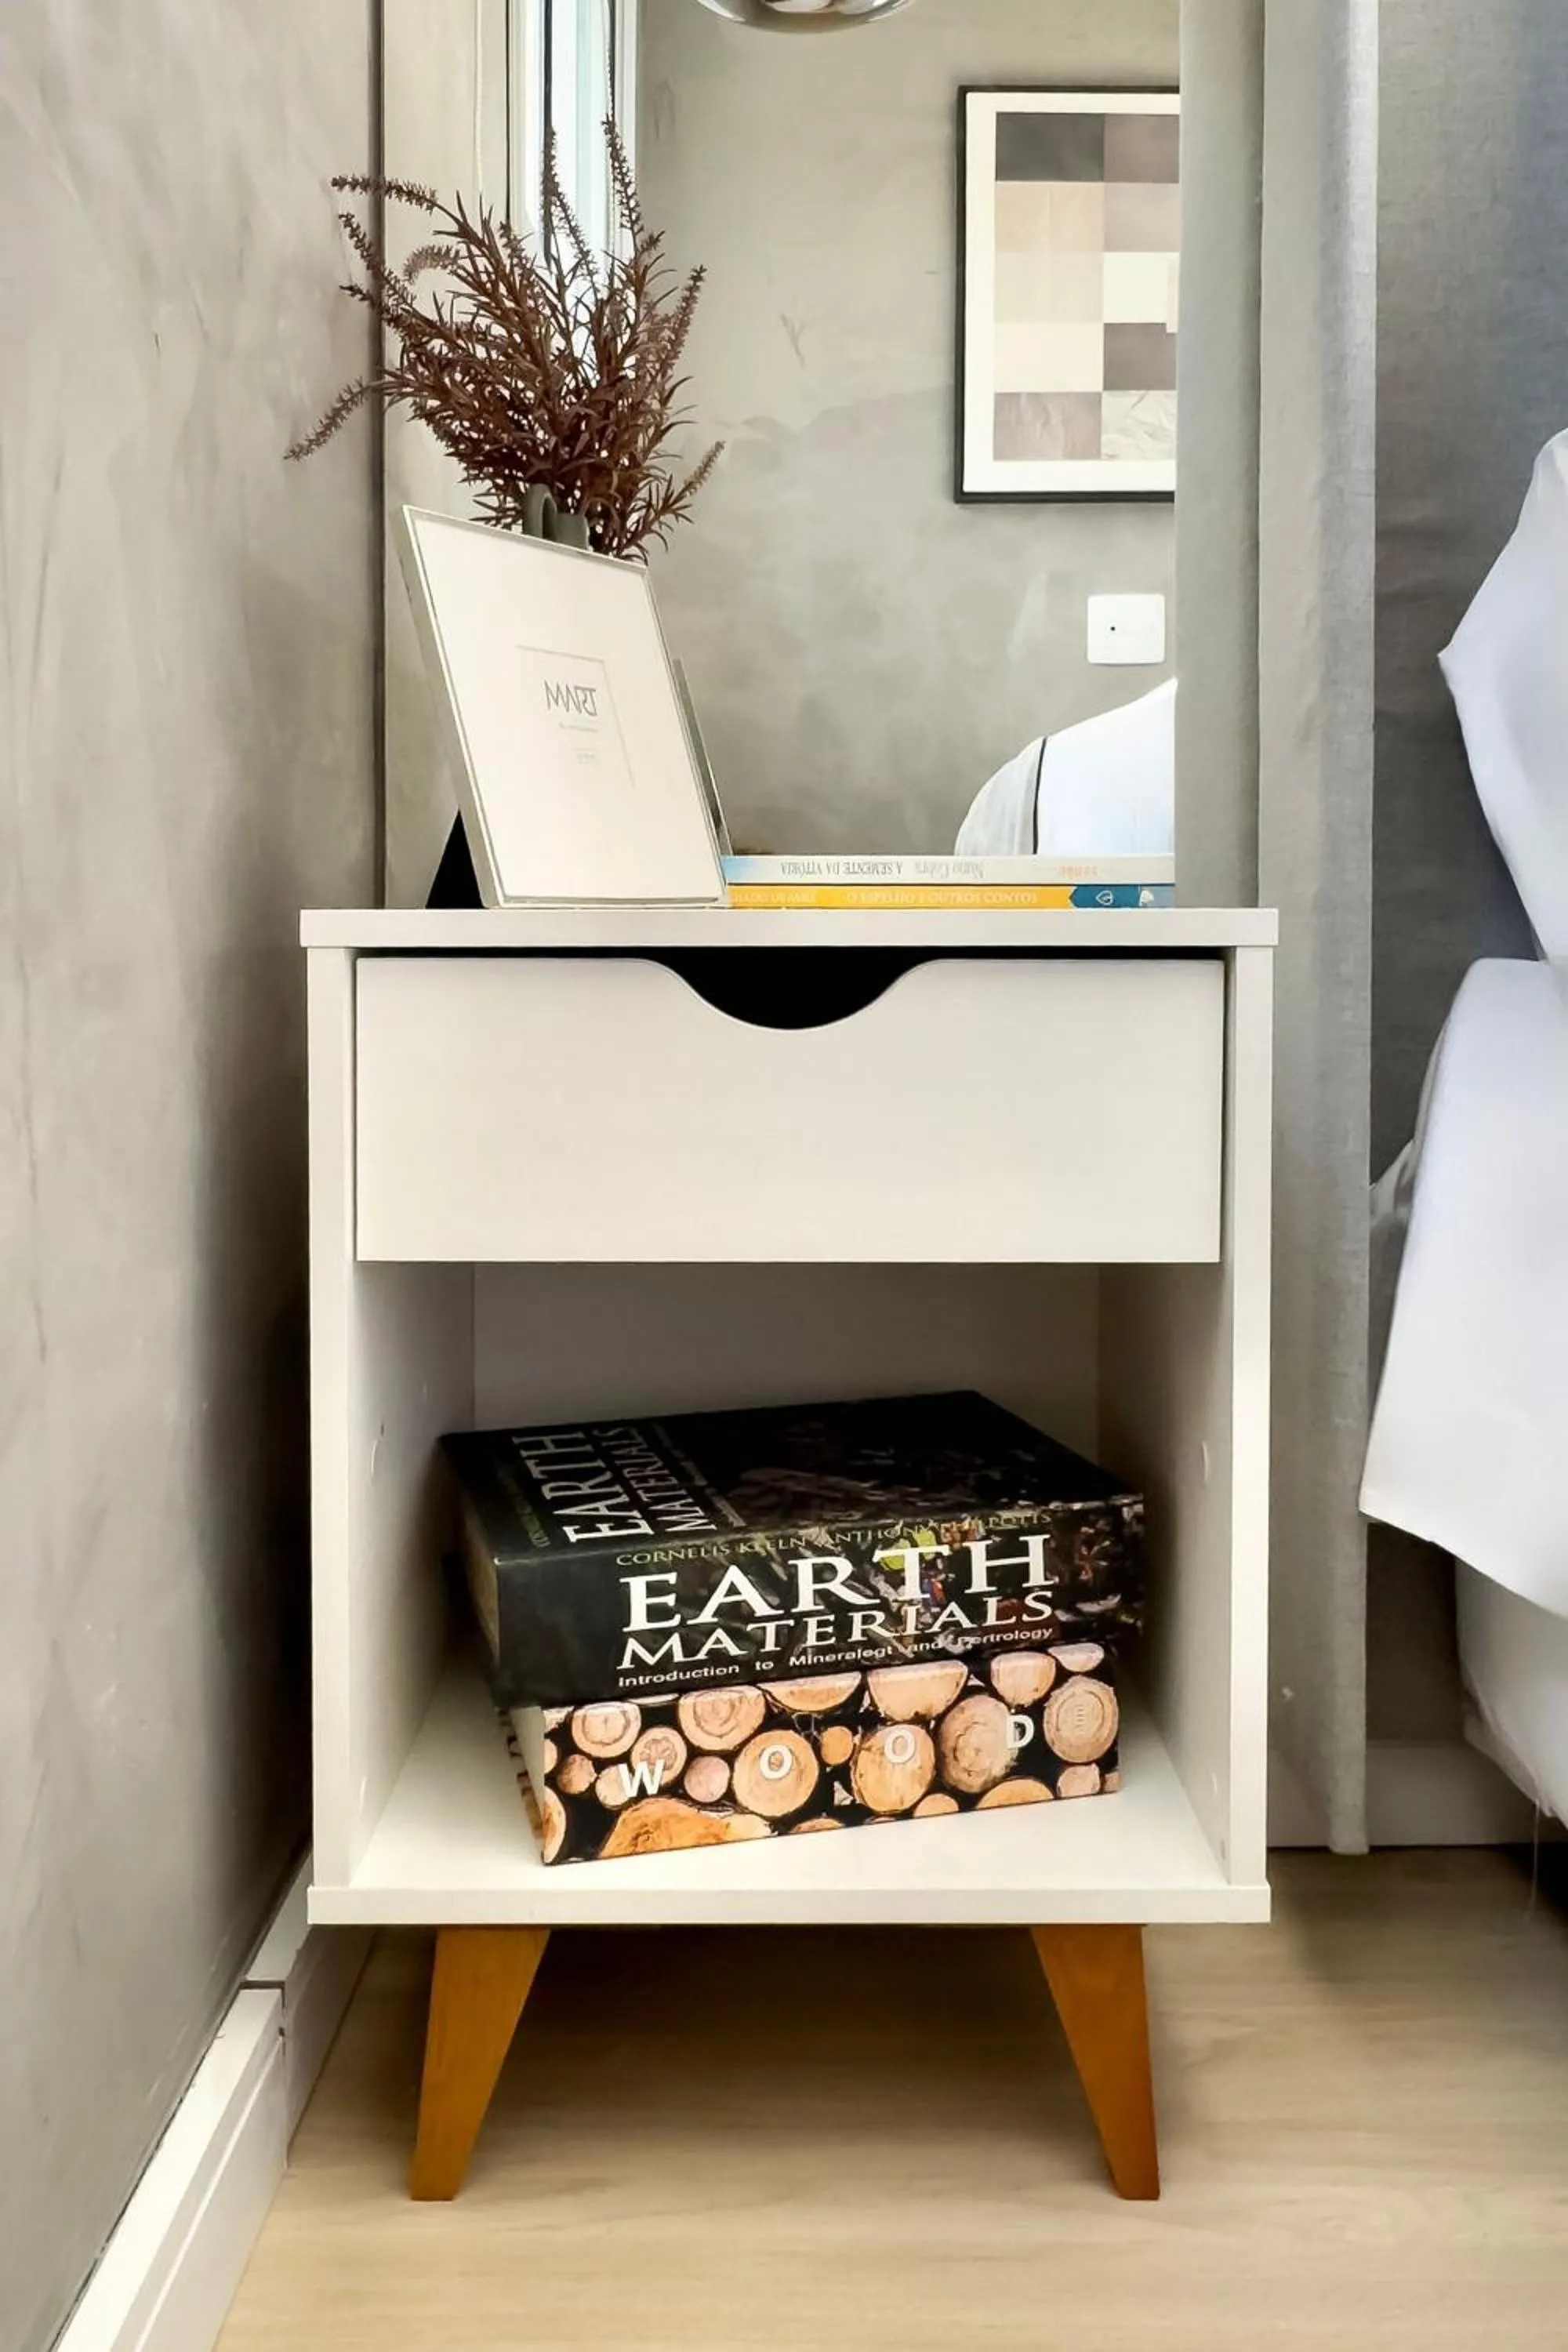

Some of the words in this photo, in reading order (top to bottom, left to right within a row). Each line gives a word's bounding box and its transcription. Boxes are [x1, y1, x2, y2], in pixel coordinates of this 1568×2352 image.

[826, 862, 840, 875] DA
[841, 862, 894, 876] SEMENTE
[512, 1430, 655, 1543] EARTH
[593, 1425, 717, 1533] MATERIALS
[616, 1544, 731, 1566] CORNELIS
[619, 1534, 1055, 1632] EARTH
[616, 1591, 1054, 1670] MATERIALS
[618, 1664, 740, 1687] Introduction
[754, 1660, 775, 1671] to
